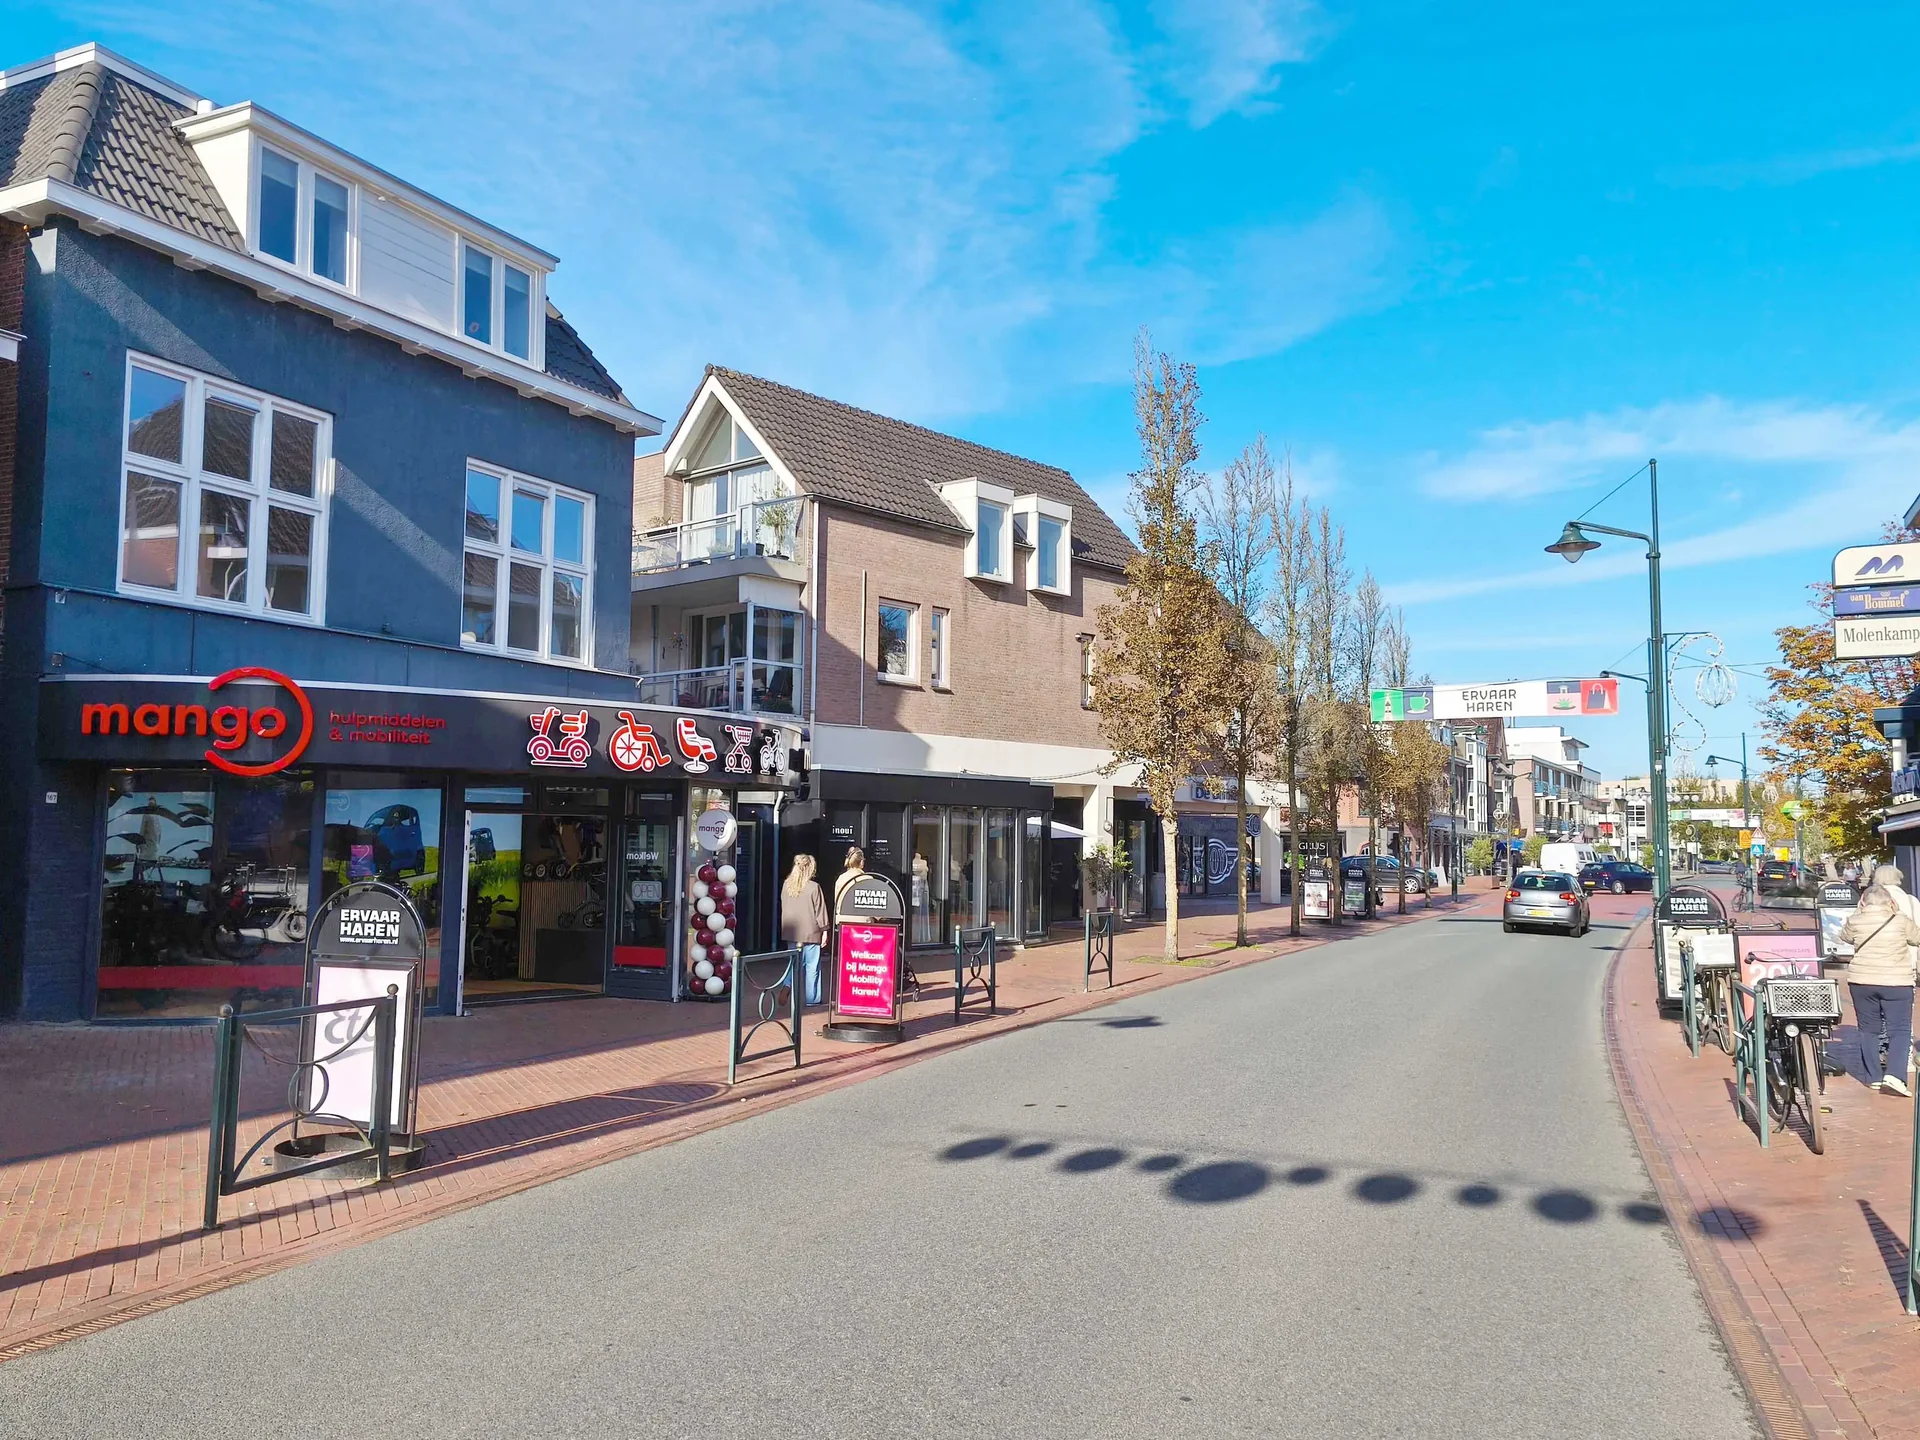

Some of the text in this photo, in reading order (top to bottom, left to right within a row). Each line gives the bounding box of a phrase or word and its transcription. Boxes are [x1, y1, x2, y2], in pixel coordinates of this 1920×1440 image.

[1843, 626, 1920, 643] Molenkamp
[1462, 689, 1517, 701] ERVAAR
[1466, 701, 1513, 712] HAREN
[328, 710, 446, 729] hulpmiddelen
[81, 703, 286, 750] mango
[328, 727, 431, 745] & mobiliteit
[854, 889, 887, 898] ERVAAR
[854, 896, 887, 906] HAREN
[1671, 903, 1709, 911] HAREN
[340, 909, 401, 923] ERVAAR
[340, 922, 400, 938] HAREN
[850, 950, 884, 960] Welkom
[845, 962, 888, 973] bij Mango
[849, 974, 884, 986] Mobility
[851, 986, 880, 997] Haren!
